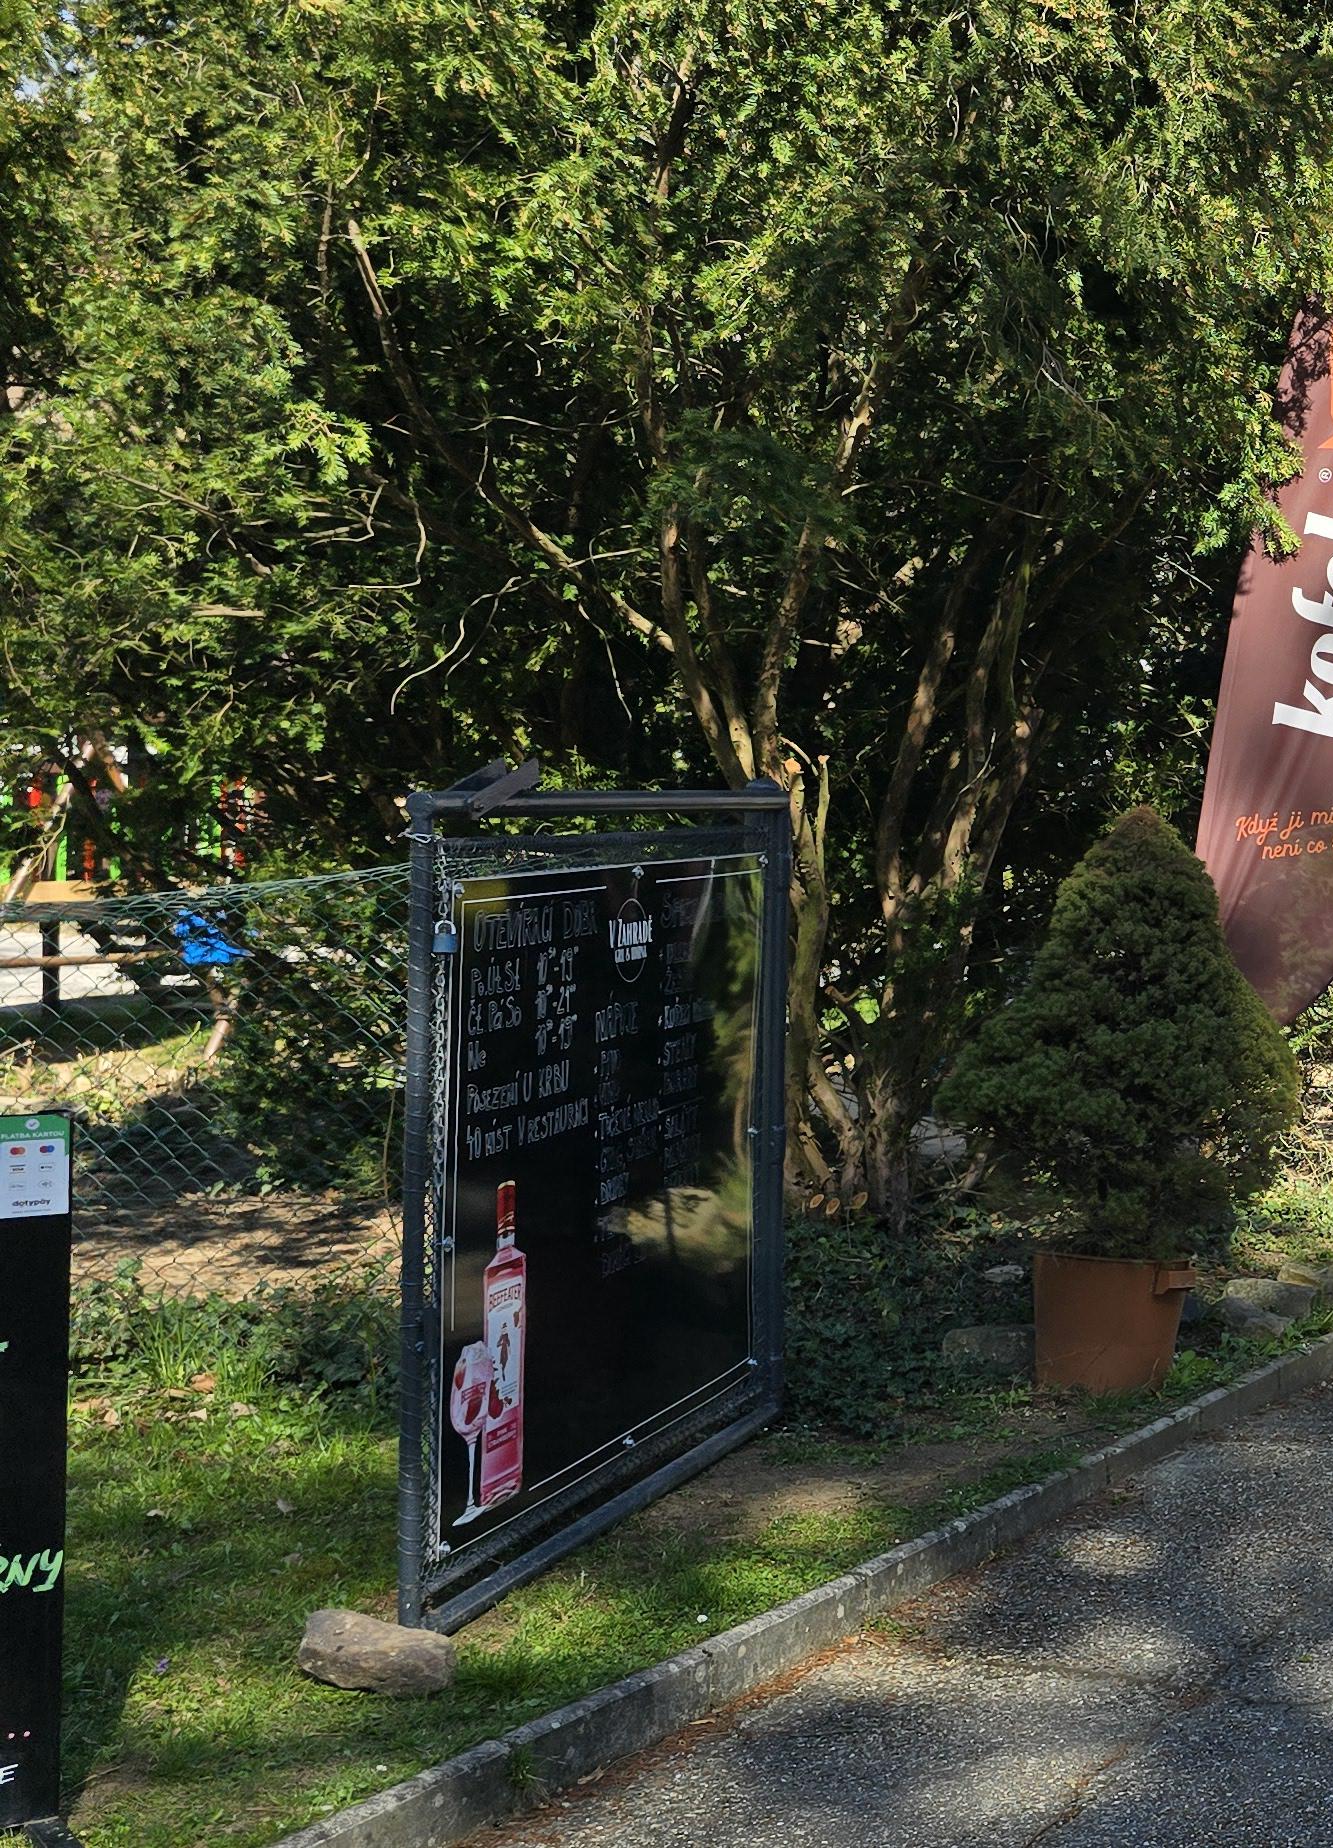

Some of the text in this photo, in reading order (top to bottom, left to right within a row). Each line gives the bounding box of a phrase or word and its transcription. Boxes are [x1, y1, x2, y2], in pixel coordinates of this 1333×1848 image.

[1235, 812, 1279, 846] Když
[1279, 811, 1305, 840] ji
[1261, 837, 1303, 860] není
[1306, 840, 1327, 854] co
[32, 1130, 65, 1138] KARTOU
[12, 1199, 51, 1207] dotypay
